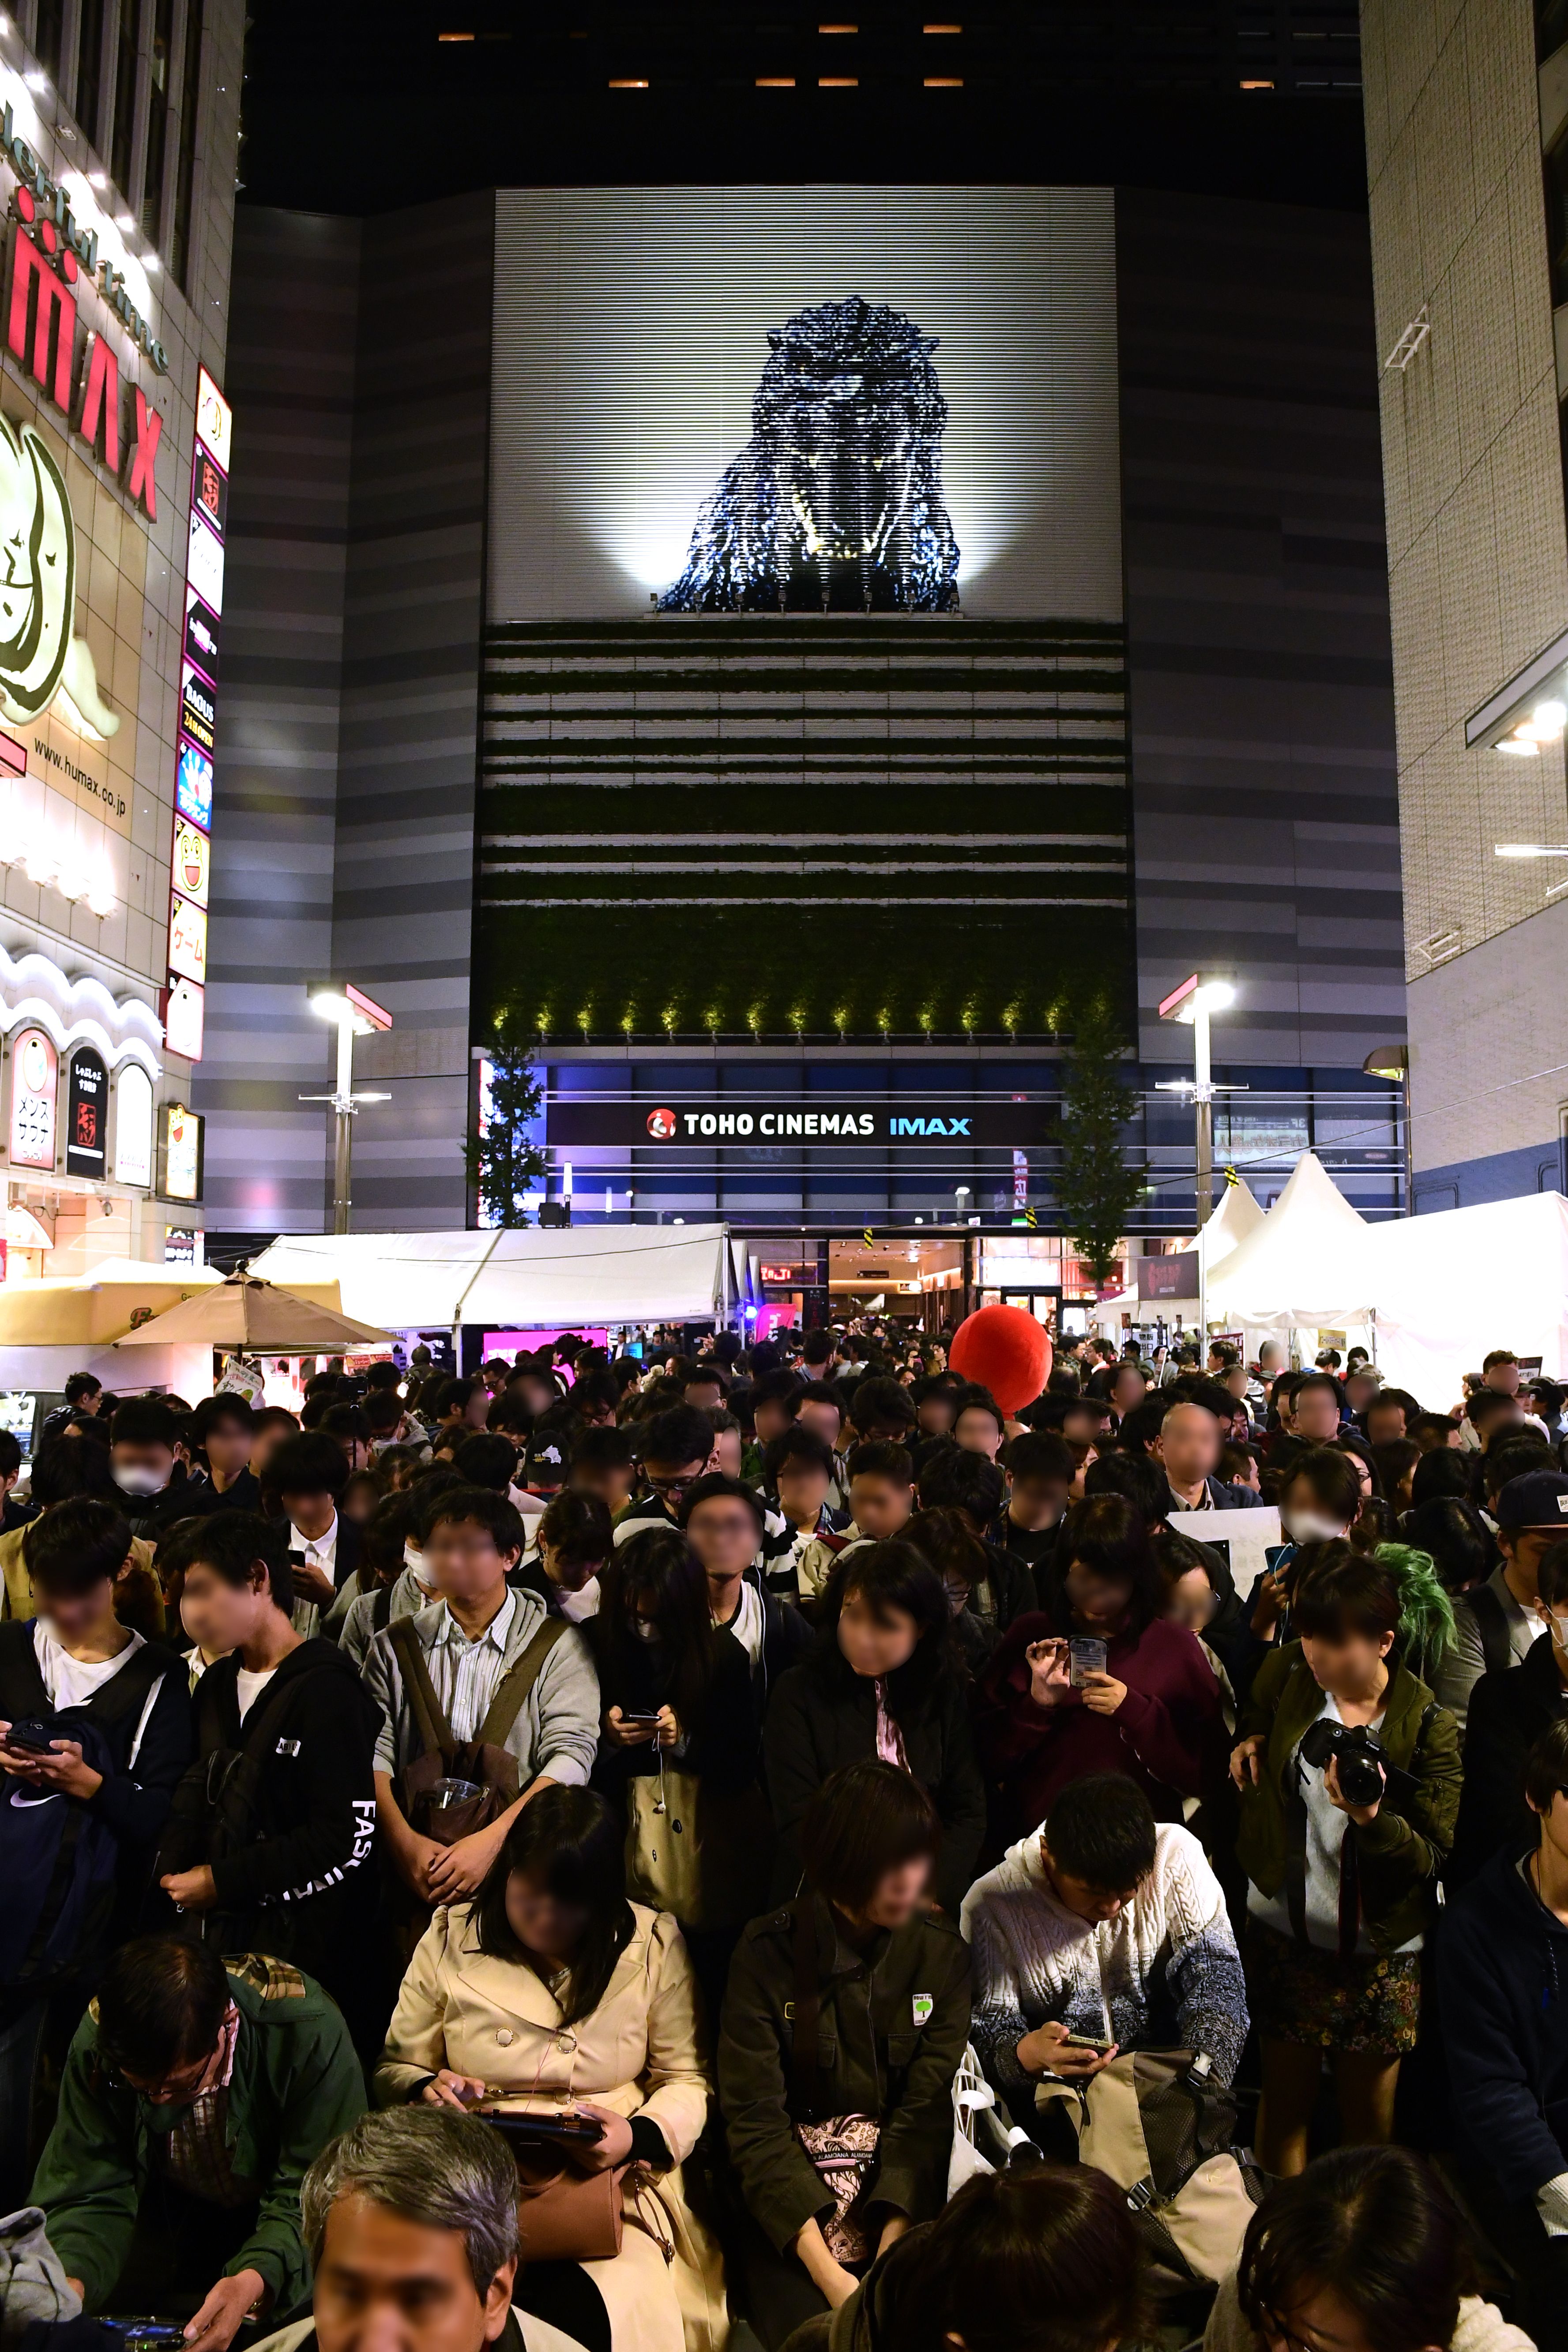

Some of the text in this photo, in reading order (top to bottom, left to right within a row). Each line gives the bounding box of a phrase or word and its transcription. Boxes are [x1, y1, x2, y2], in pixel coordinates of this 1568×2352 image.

[105, 260, 169, 370] time
[186, 684, 214, 723] BAGUS
[197, 727, 213, 748] OPEN
[35, 738, 126, 817] www.humax.co.jp
[19, 1120, 49, 1144] サウナ
[684, 1114, 874, 1135] TOHO CINEMAS
[890, 1118, 971, 1135] IMAX
[1365, 1741, 1380, 1751] Canon
